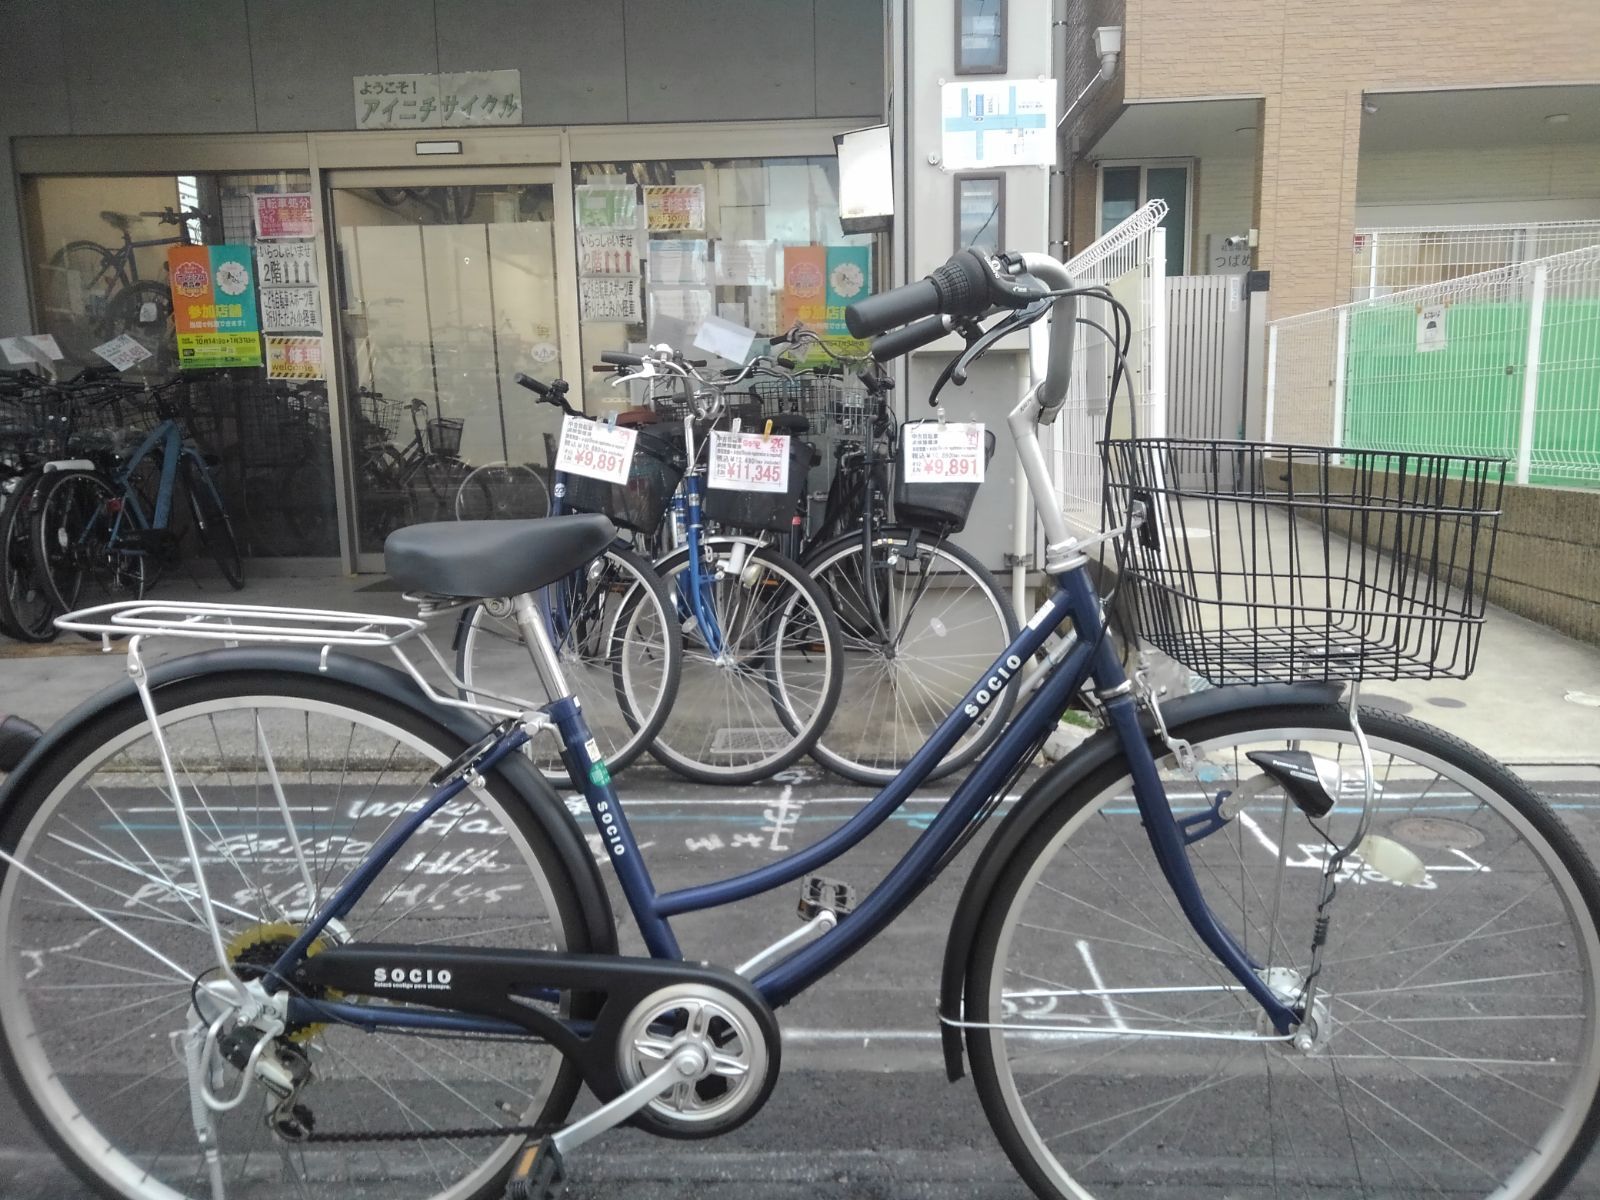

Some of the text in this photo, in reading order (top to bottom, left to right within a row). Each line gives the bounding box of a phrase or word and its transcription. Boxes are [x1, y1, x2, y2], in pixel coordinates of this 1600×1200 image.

[360, 93, 519, 123] アイニチサイクル
[259, 244, 311, 258] いらっしゃいませ
[580, 232, 634, 248] いらっしゃいませ
[964, 655, 1021, 718] SOCIO
[597, 801, 625, 855] SOCIO
[374, 967, 452, 984] SOCIO
